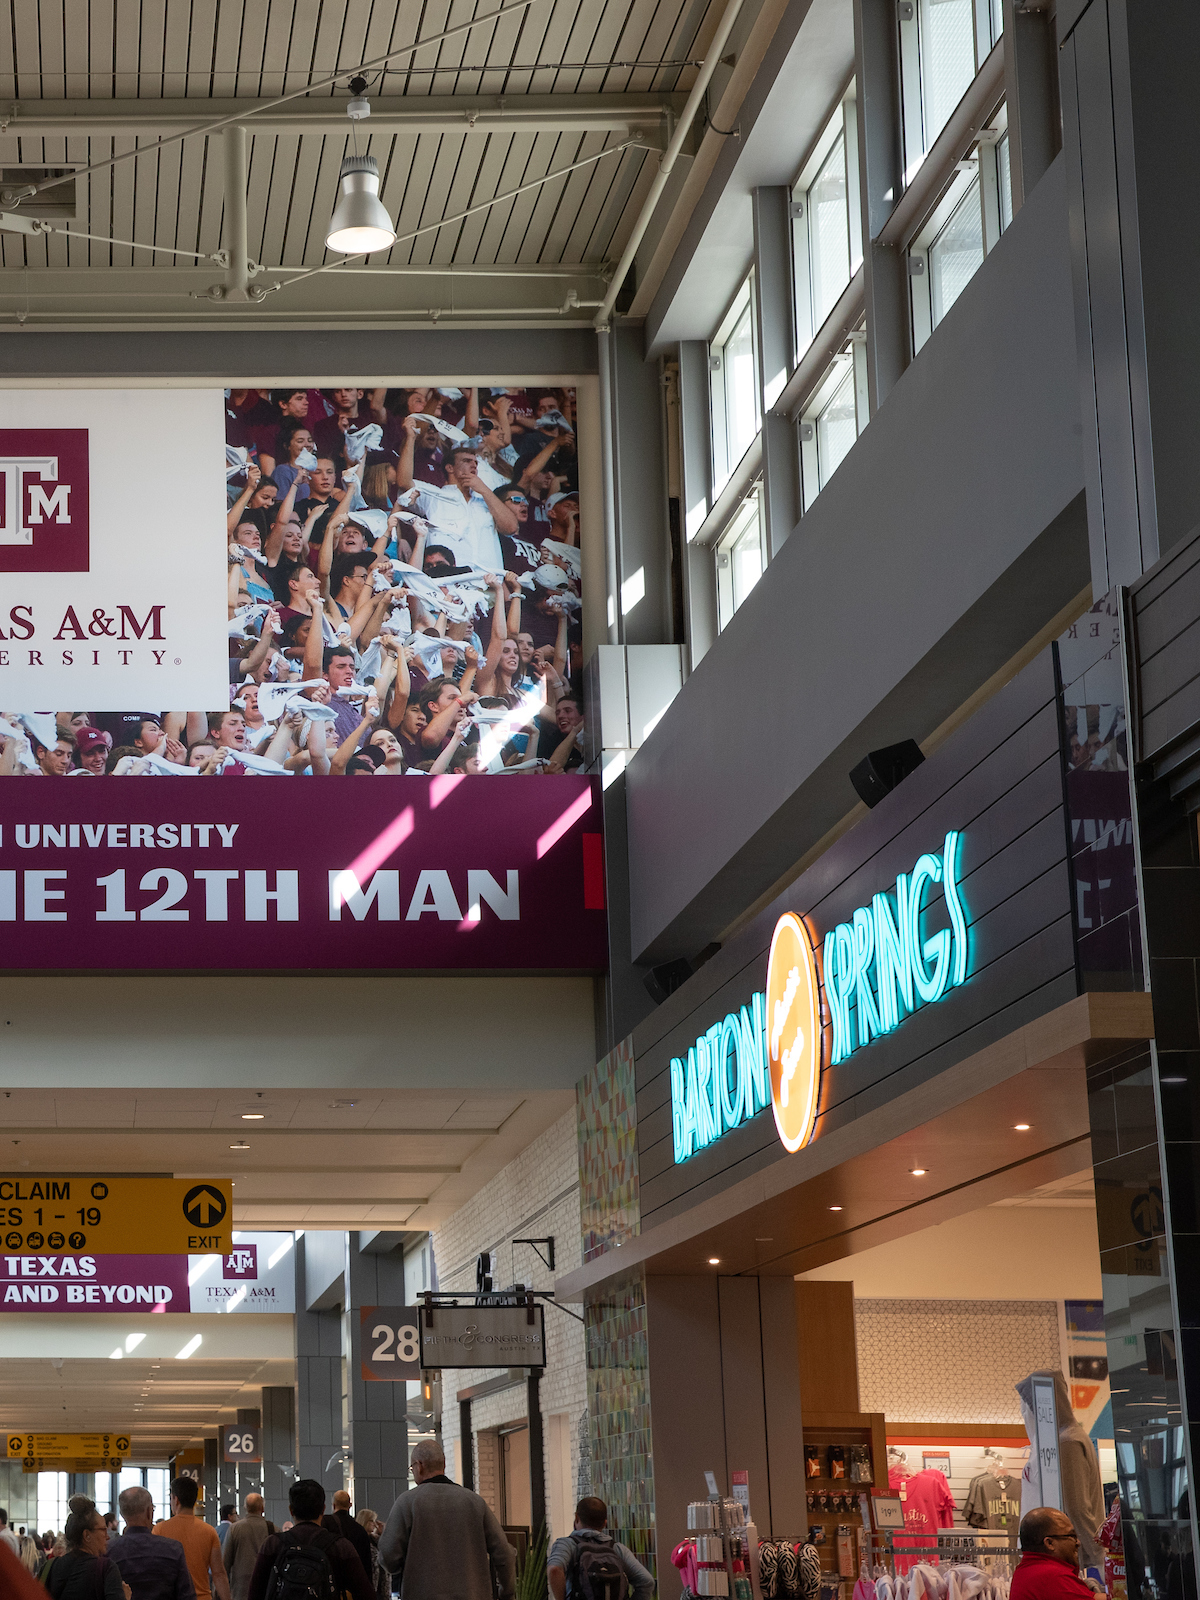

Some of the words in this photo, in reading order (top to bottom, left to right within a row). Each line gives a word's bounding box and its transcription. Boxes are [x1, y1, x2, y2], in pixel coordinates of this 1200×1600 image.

[53, 605, 166, 641] A&M
[15, 823, 239, 848] UNIVERSITY
[95, 867, 299, 922] 12TH
[328, 869, 521, 922] MAN
[670, 991, 771, 1164] BARTON
[822, 830, 968, 1065] SPRINGS
[34, 1208, 43, 1226] 1
[77, 1208, 101, 1226] 19
[188, 1236, 222, 1248] EXIT
[5, 1256, 97, 1277] TEXAS
[4, 1285, 59, 1303] AND
[67, 1285, 173, 1303] BEYOND
[249, 1287, 276, 1297] A&M
[371, 1324, 419, 1362] 28
[424, 1335, 457, 1345] FIFTH
[475, 1334, 540, 1345] CONGRESS
[1038, 1406, 1053, 1423] SALE
[229, 1433, 254, 1453] 26
[903, 1508, 928, 1524] ustin
